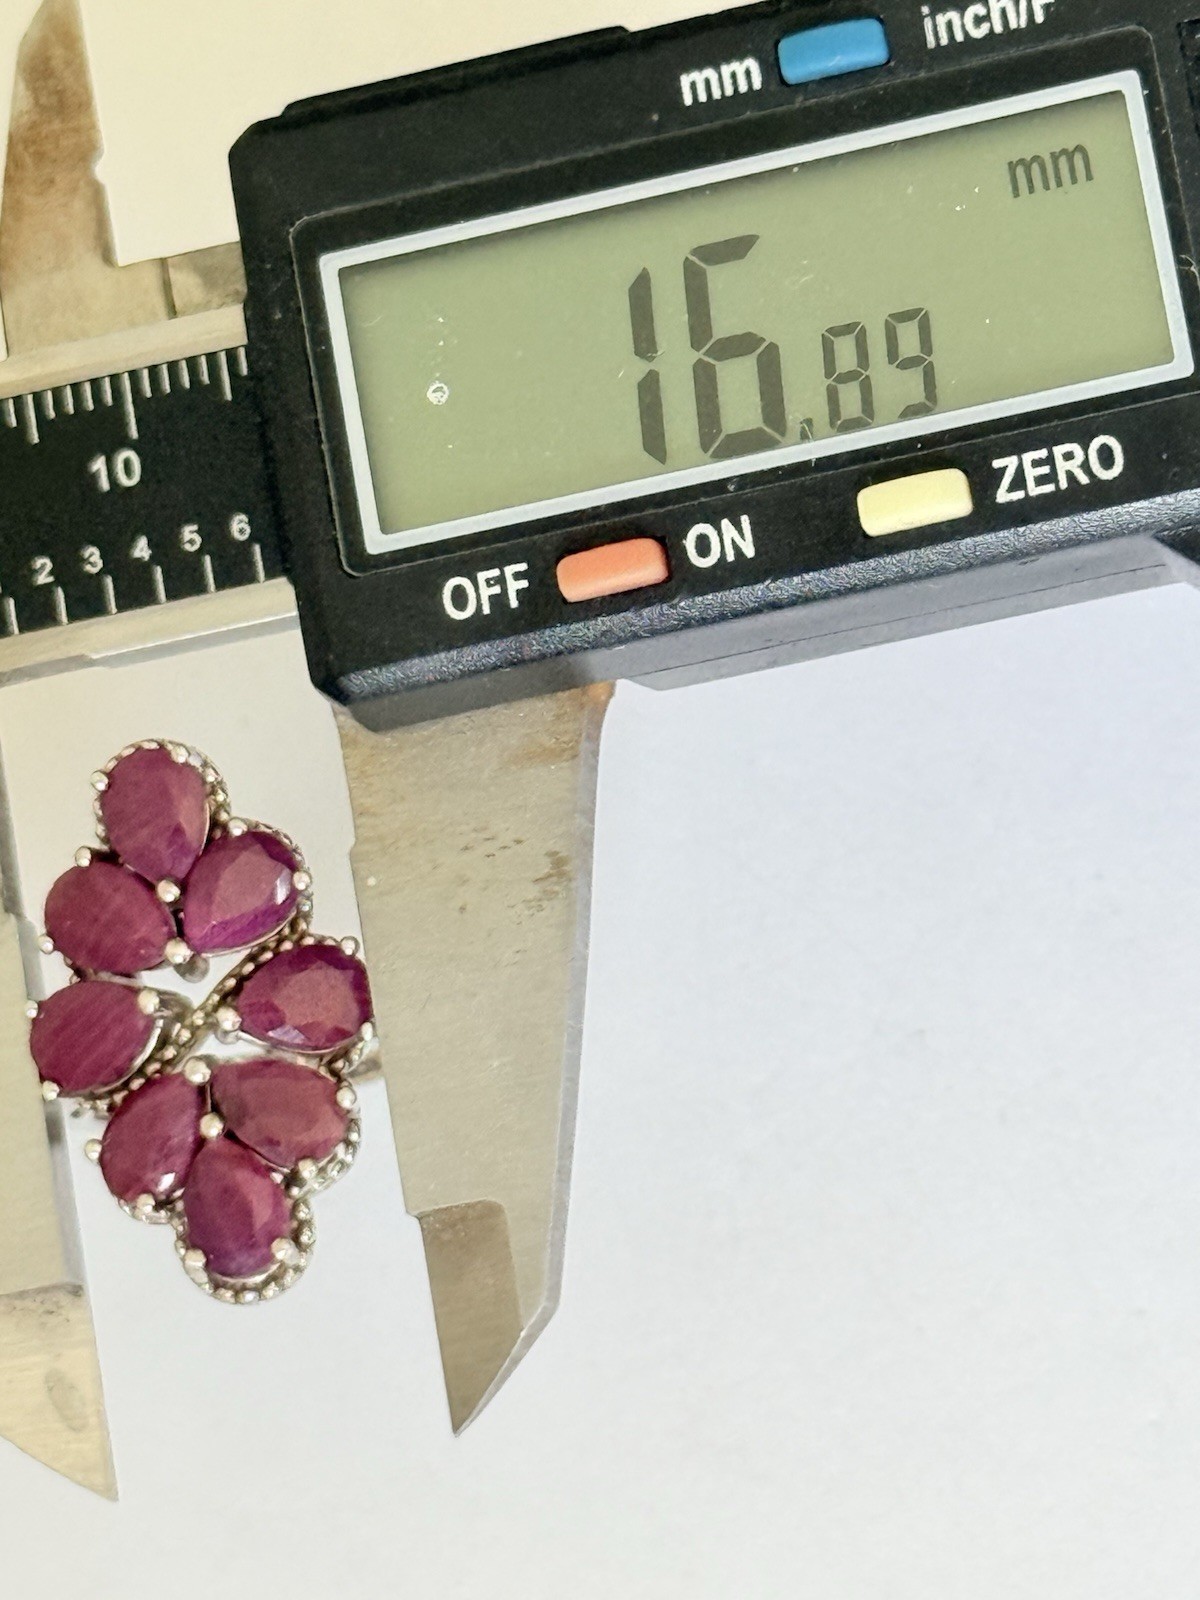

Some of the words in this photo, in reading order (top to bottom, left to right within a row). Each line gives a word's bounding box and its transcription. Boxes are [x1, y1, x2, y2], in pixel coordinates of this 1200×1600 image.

[680, 56, 763, 106] mm
[1007, 143, 1094, 198] mm
[627, 234, 938, 465] 16.89
[88, 448, 142, 492] 10
[991, 434, 1125, 503] ZERO
[31, 555, 55, 586] 2
[80, 545, 104, 574] 3
[130, 534, 152, 562] 4
[179, 523, 202, 552] 5
[228, 512, 252, 542] 6
[683, 514, 756, 568] ON
[442, 562, 529, 621] OFF
